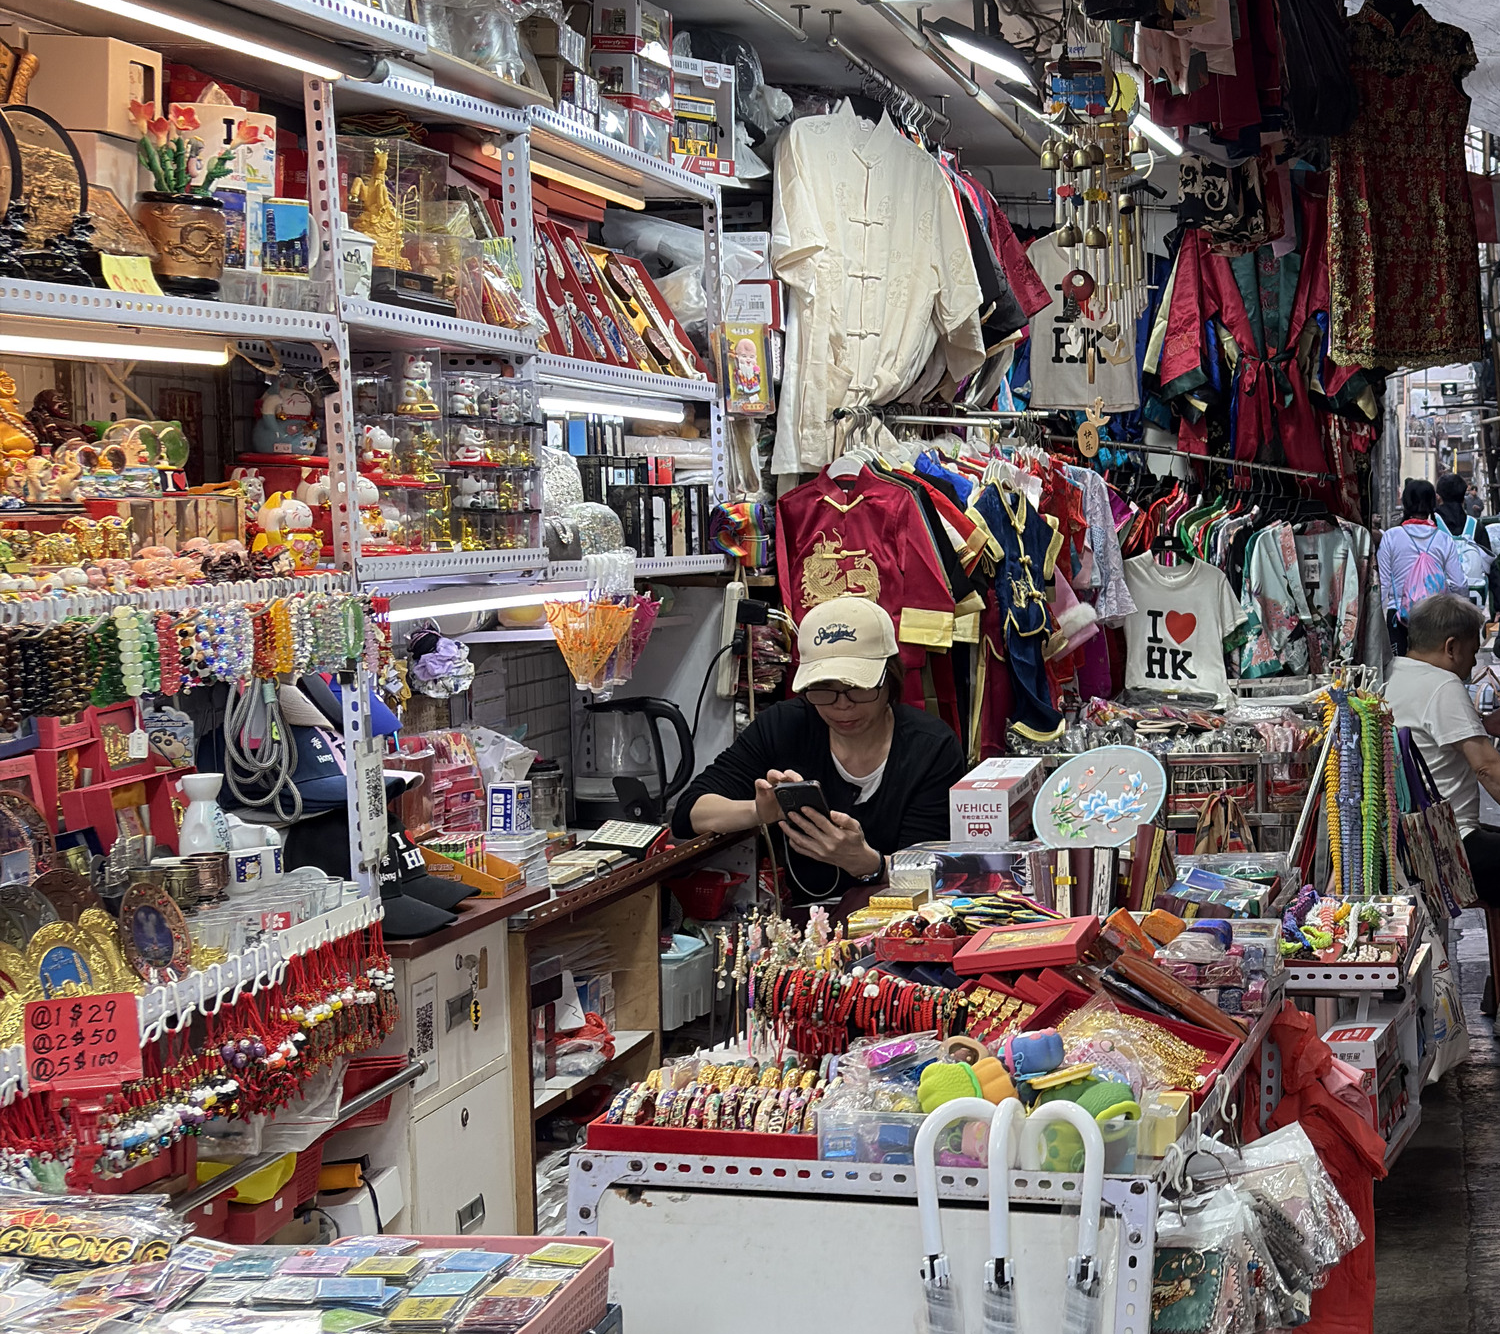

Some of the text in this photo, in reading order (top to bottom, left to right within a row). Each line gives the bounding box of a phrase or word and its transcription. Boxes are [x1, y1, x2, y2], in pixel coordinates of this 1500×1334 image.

[1083, 429, 1094, 451] 快乐
[1147, 610, 1163, 643] I
[1145, 645, 1197, 681] HK
[956, 803, 1002, 812] VEHICLE
[391, 833, 407, 849] I
